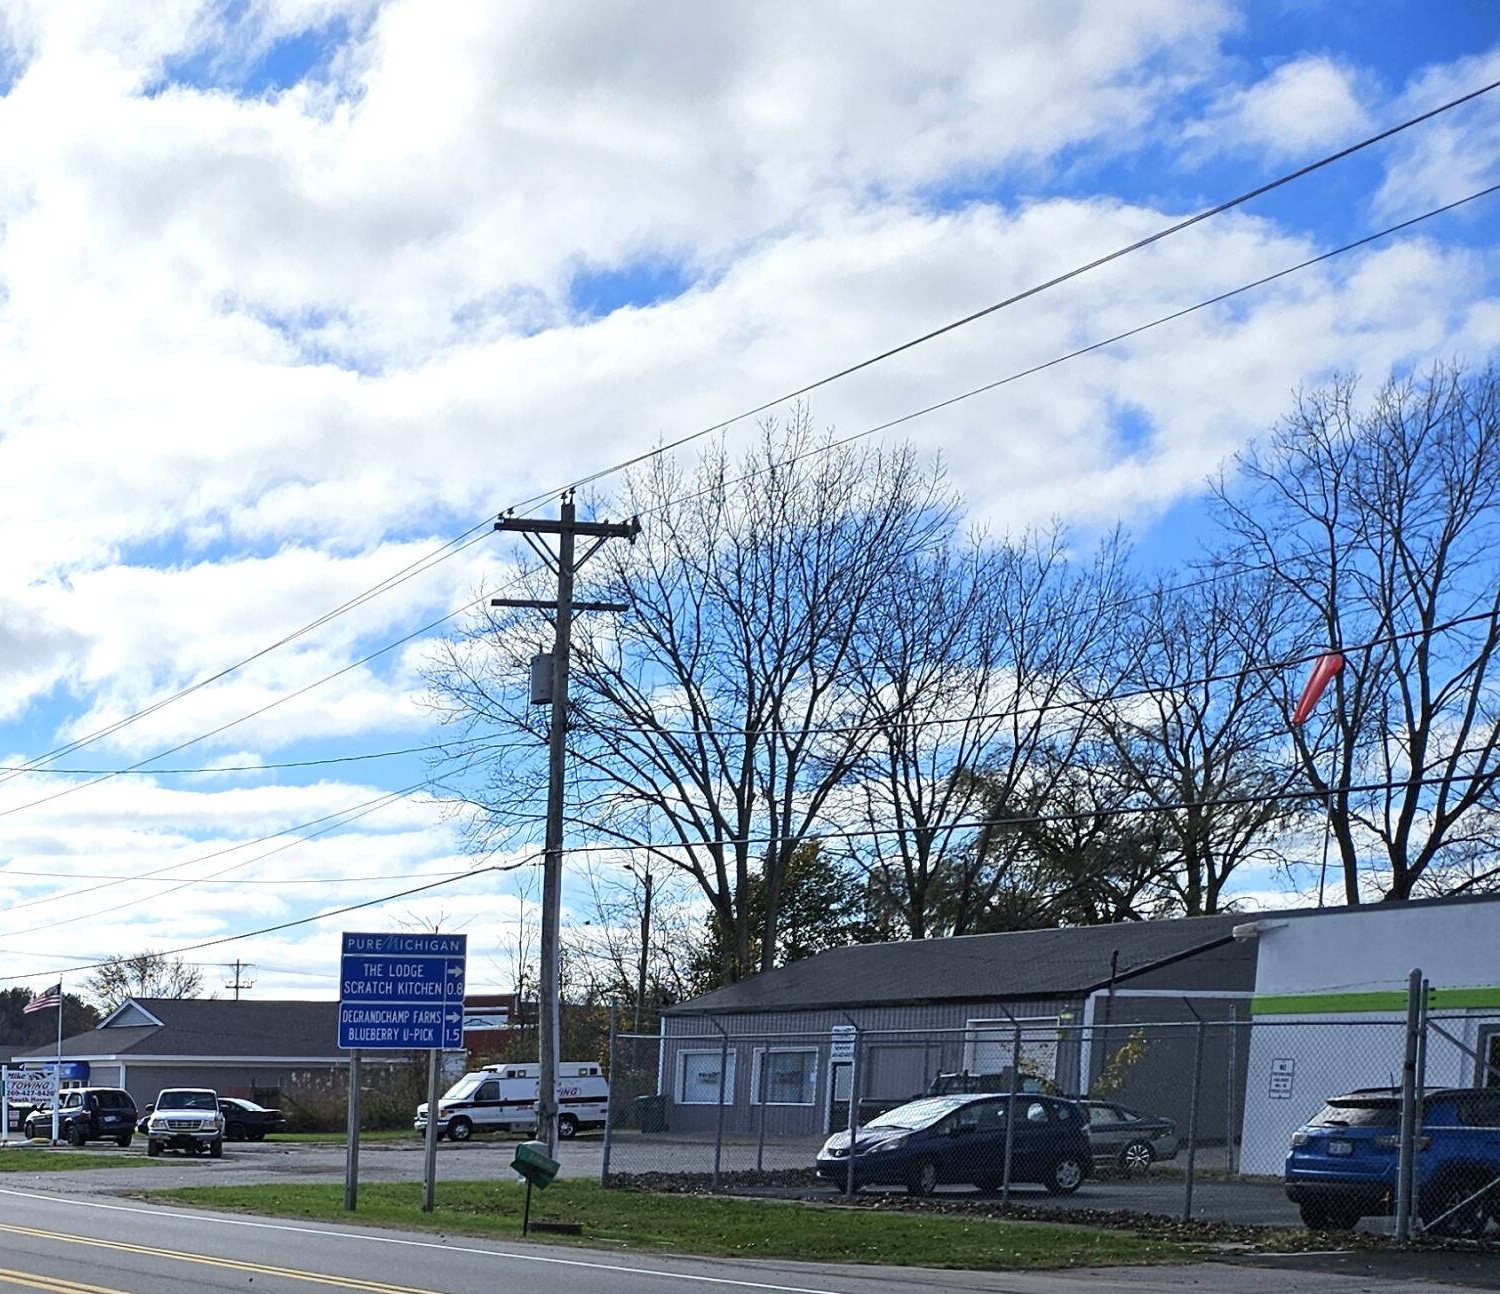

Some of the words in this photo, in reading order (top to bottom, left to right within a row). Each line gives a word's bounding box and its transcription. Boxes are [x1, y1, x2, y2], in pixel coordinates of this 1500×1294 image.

[348, 938, 383, 950] PURE
[383, 935, 460, 951] MICHIGAN
[363, 963, 384, 977] THE
[389, 963, 425, 978] LODGE
[343, 980, 393, 994] SCRATCH
[397, 981, 442, 995] KITCHEN
[446, 982, 464, 996] 0.8
[342, 1009, 410, 1024] DEGRANDCHAMP
[412, 1010, 442, 1024] FARMS
[348, 1027, 399, 1041] BLUEBERRY
[403, 1028, 434, 1042] U-PICK
[446, 1028, 460, 1042] 1.5
[7, 1072, 33, 1080] Mike's
[11, 1081, 50, 1090] TOWING
